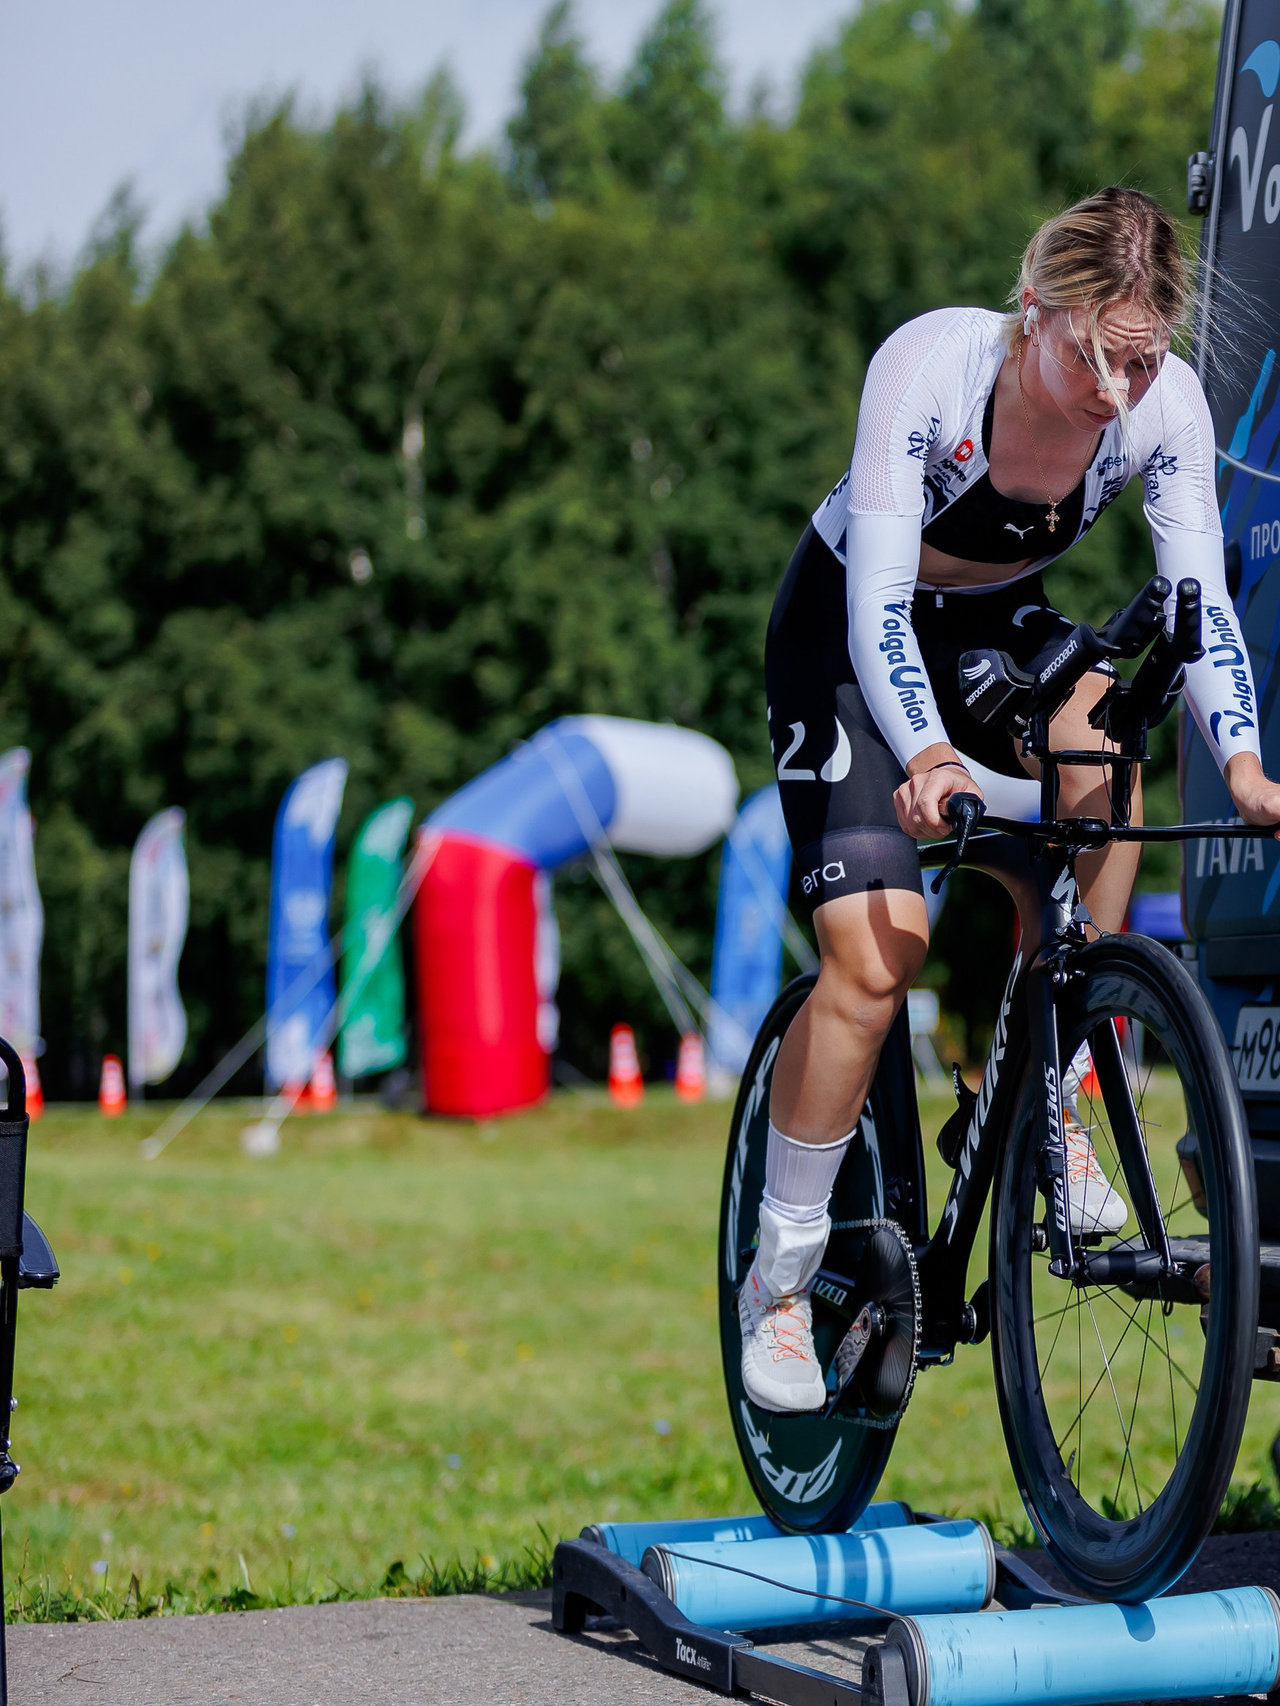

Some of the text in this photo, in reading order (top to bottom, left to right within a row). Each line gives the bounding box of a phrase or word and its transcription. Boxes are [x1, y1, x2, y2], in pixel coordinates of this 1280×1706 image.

[1039, 639, 1078, 684] aerocoach
[965, 673, 997, 707] aerocoach
[676, 1637, 697, 1666] Tacx
